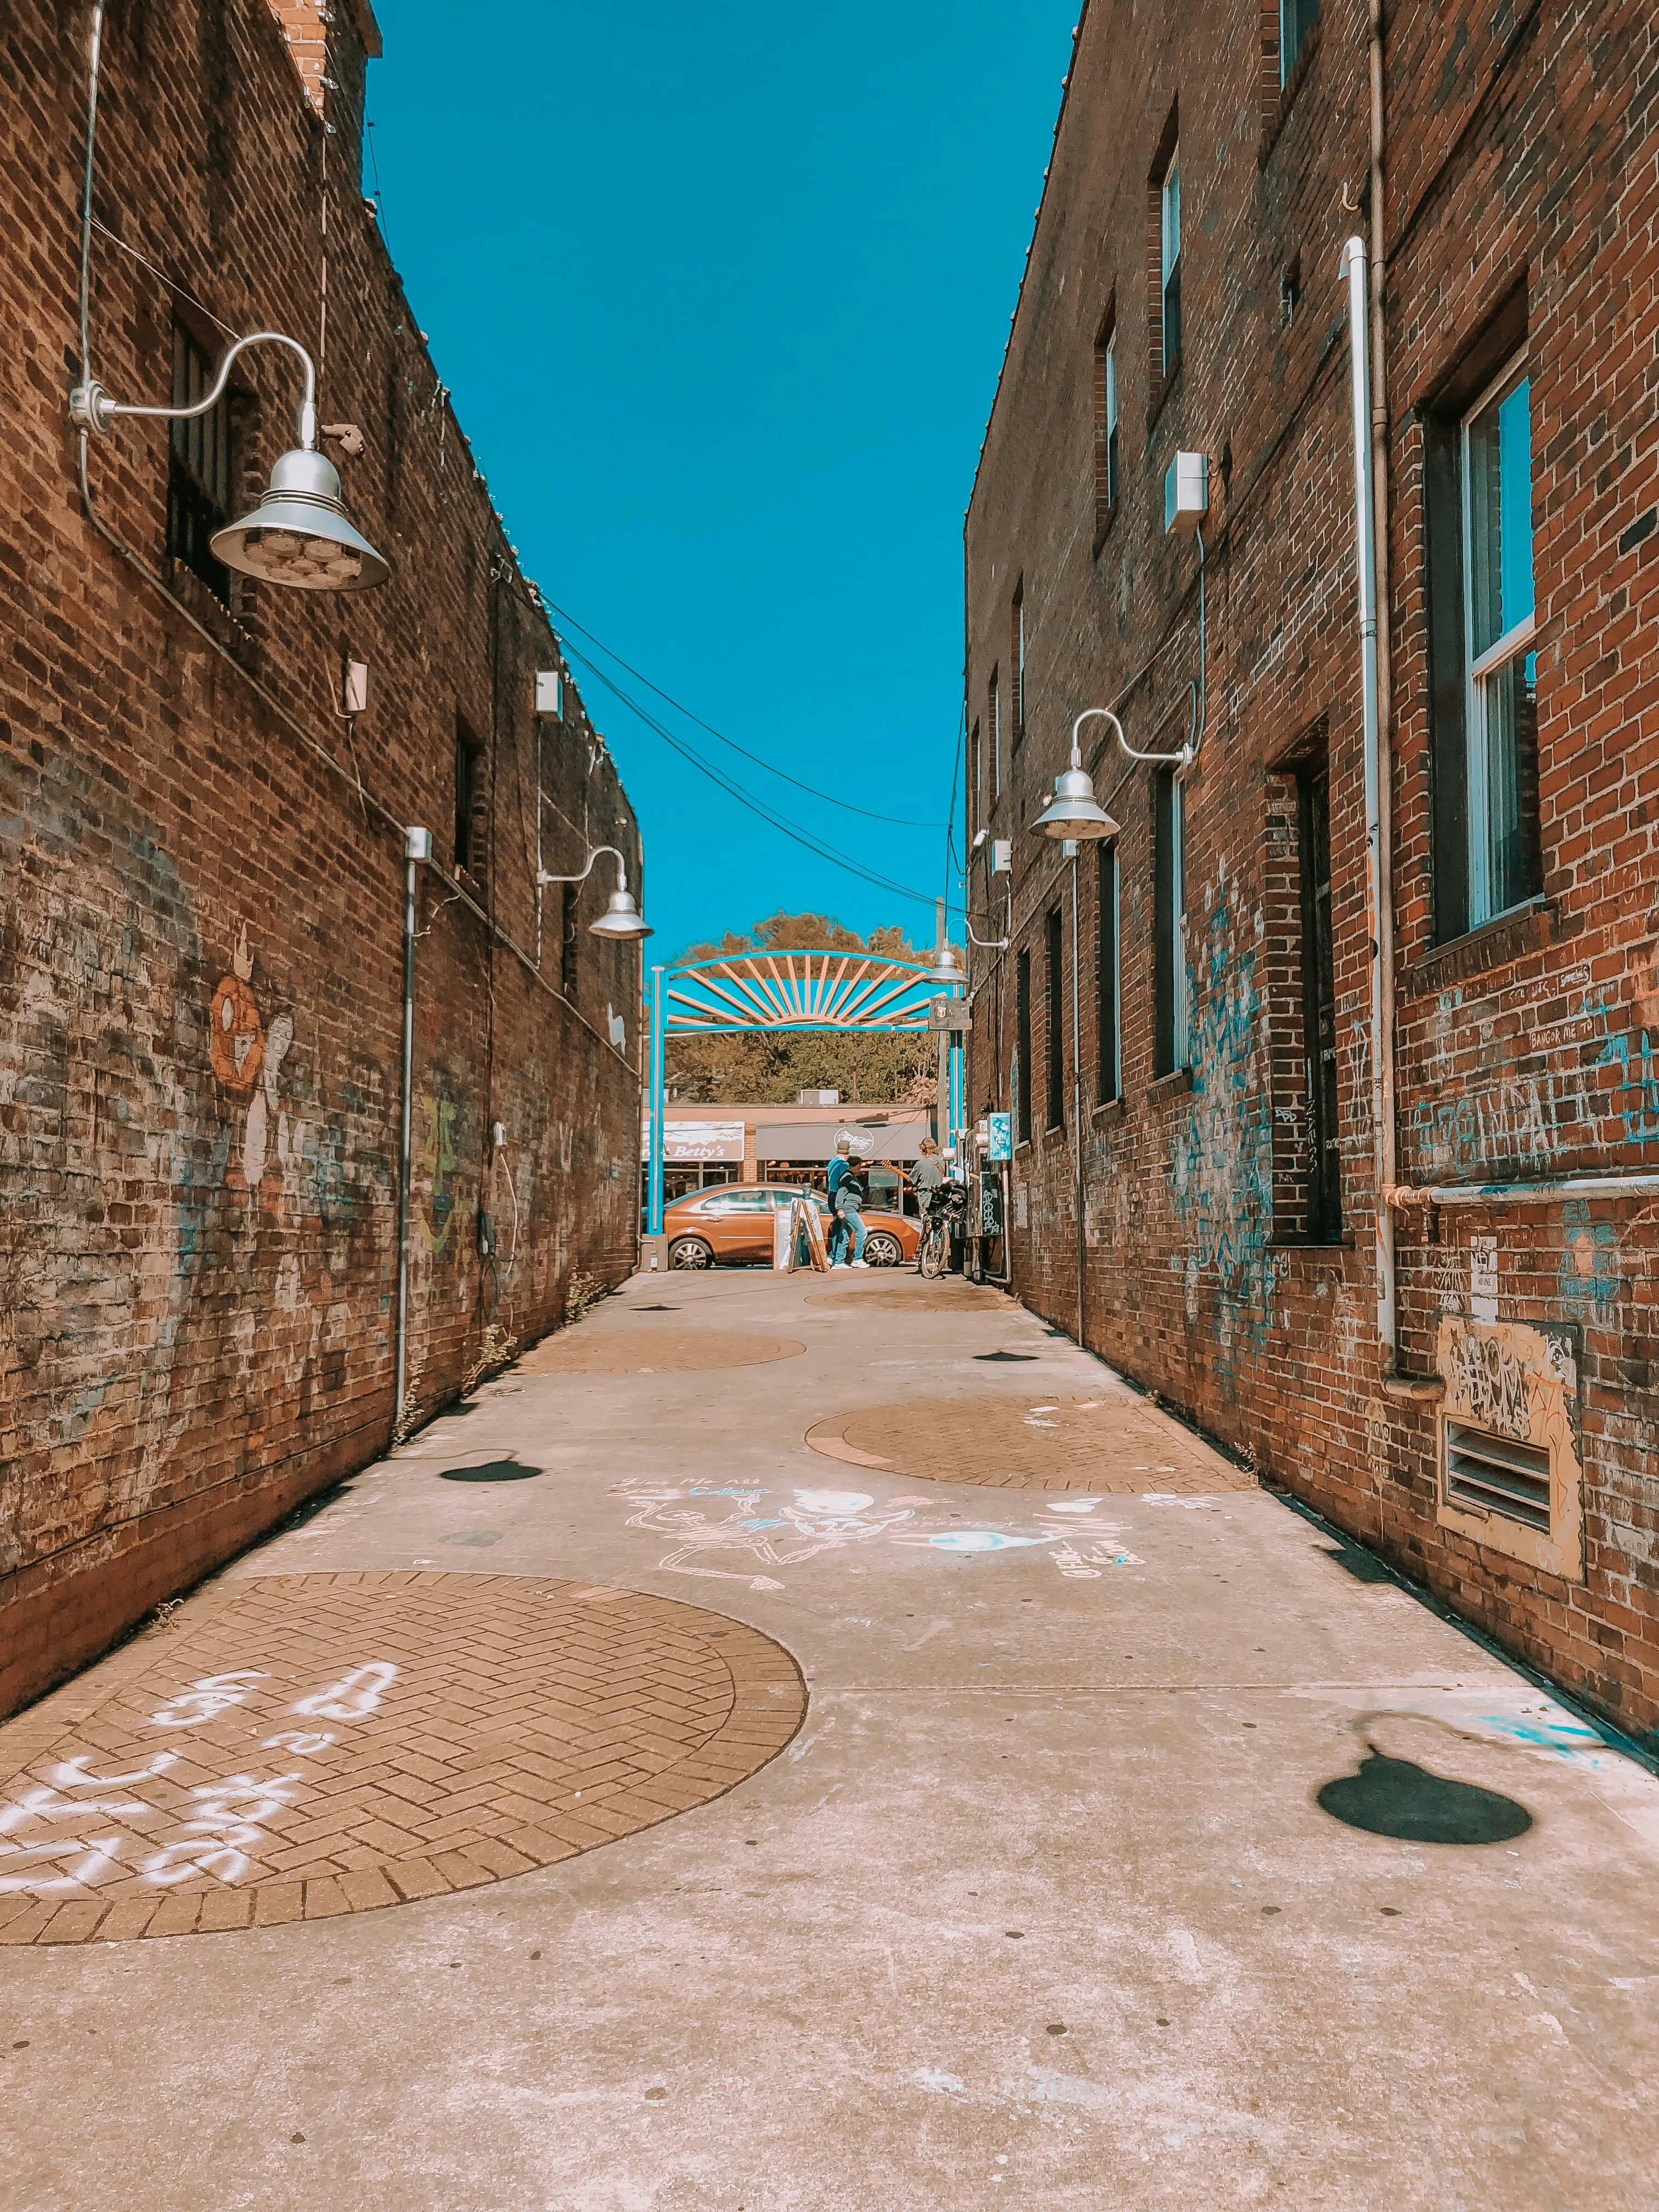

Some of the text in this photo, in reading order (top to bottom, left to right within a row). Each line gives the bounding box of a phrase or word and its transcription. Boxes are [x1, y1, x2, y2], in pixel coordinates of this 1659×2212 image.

[1531, 1018, 1593, 1049] BANGOR ME TO
[673, 1145, 725, 1160] Betty's
